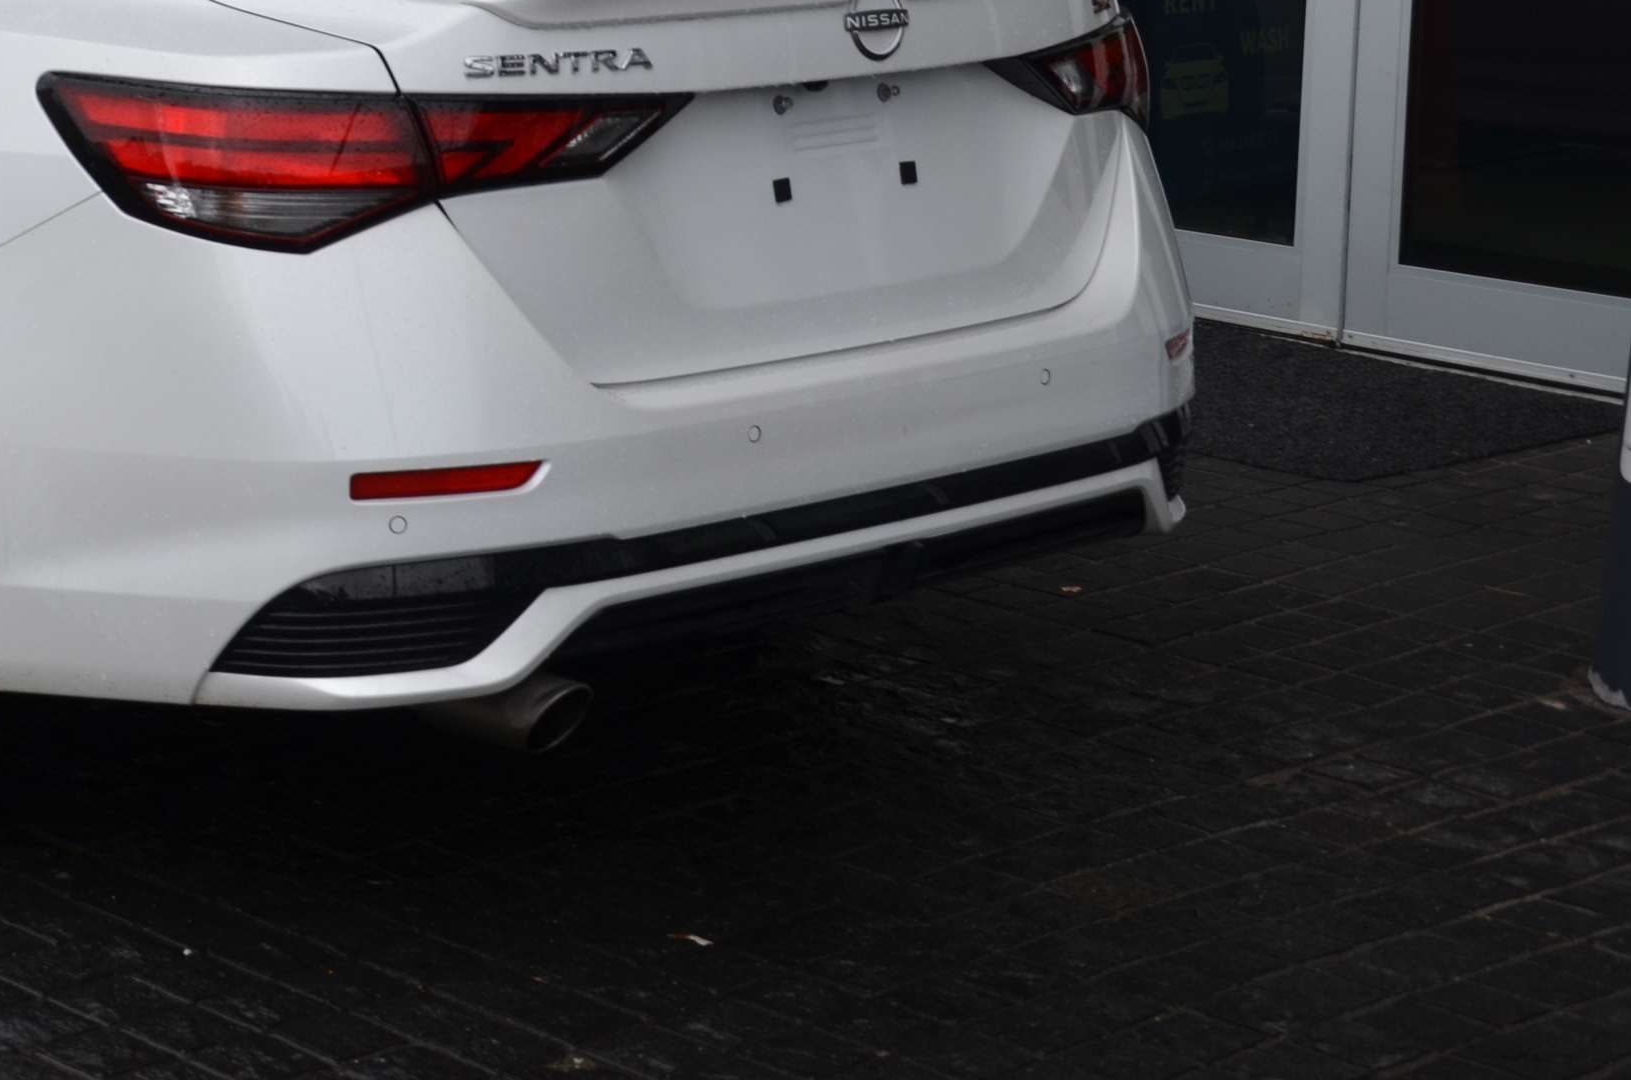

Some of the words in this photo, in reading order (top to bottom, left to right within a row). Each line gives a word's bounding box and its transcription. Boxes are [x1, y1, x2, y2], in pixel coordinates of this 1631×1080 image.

[846, 11, 909, 31] NISSAN
[1239, 26, 1291, 57] WASH
[463, 47, 655, 79] SENTRA
